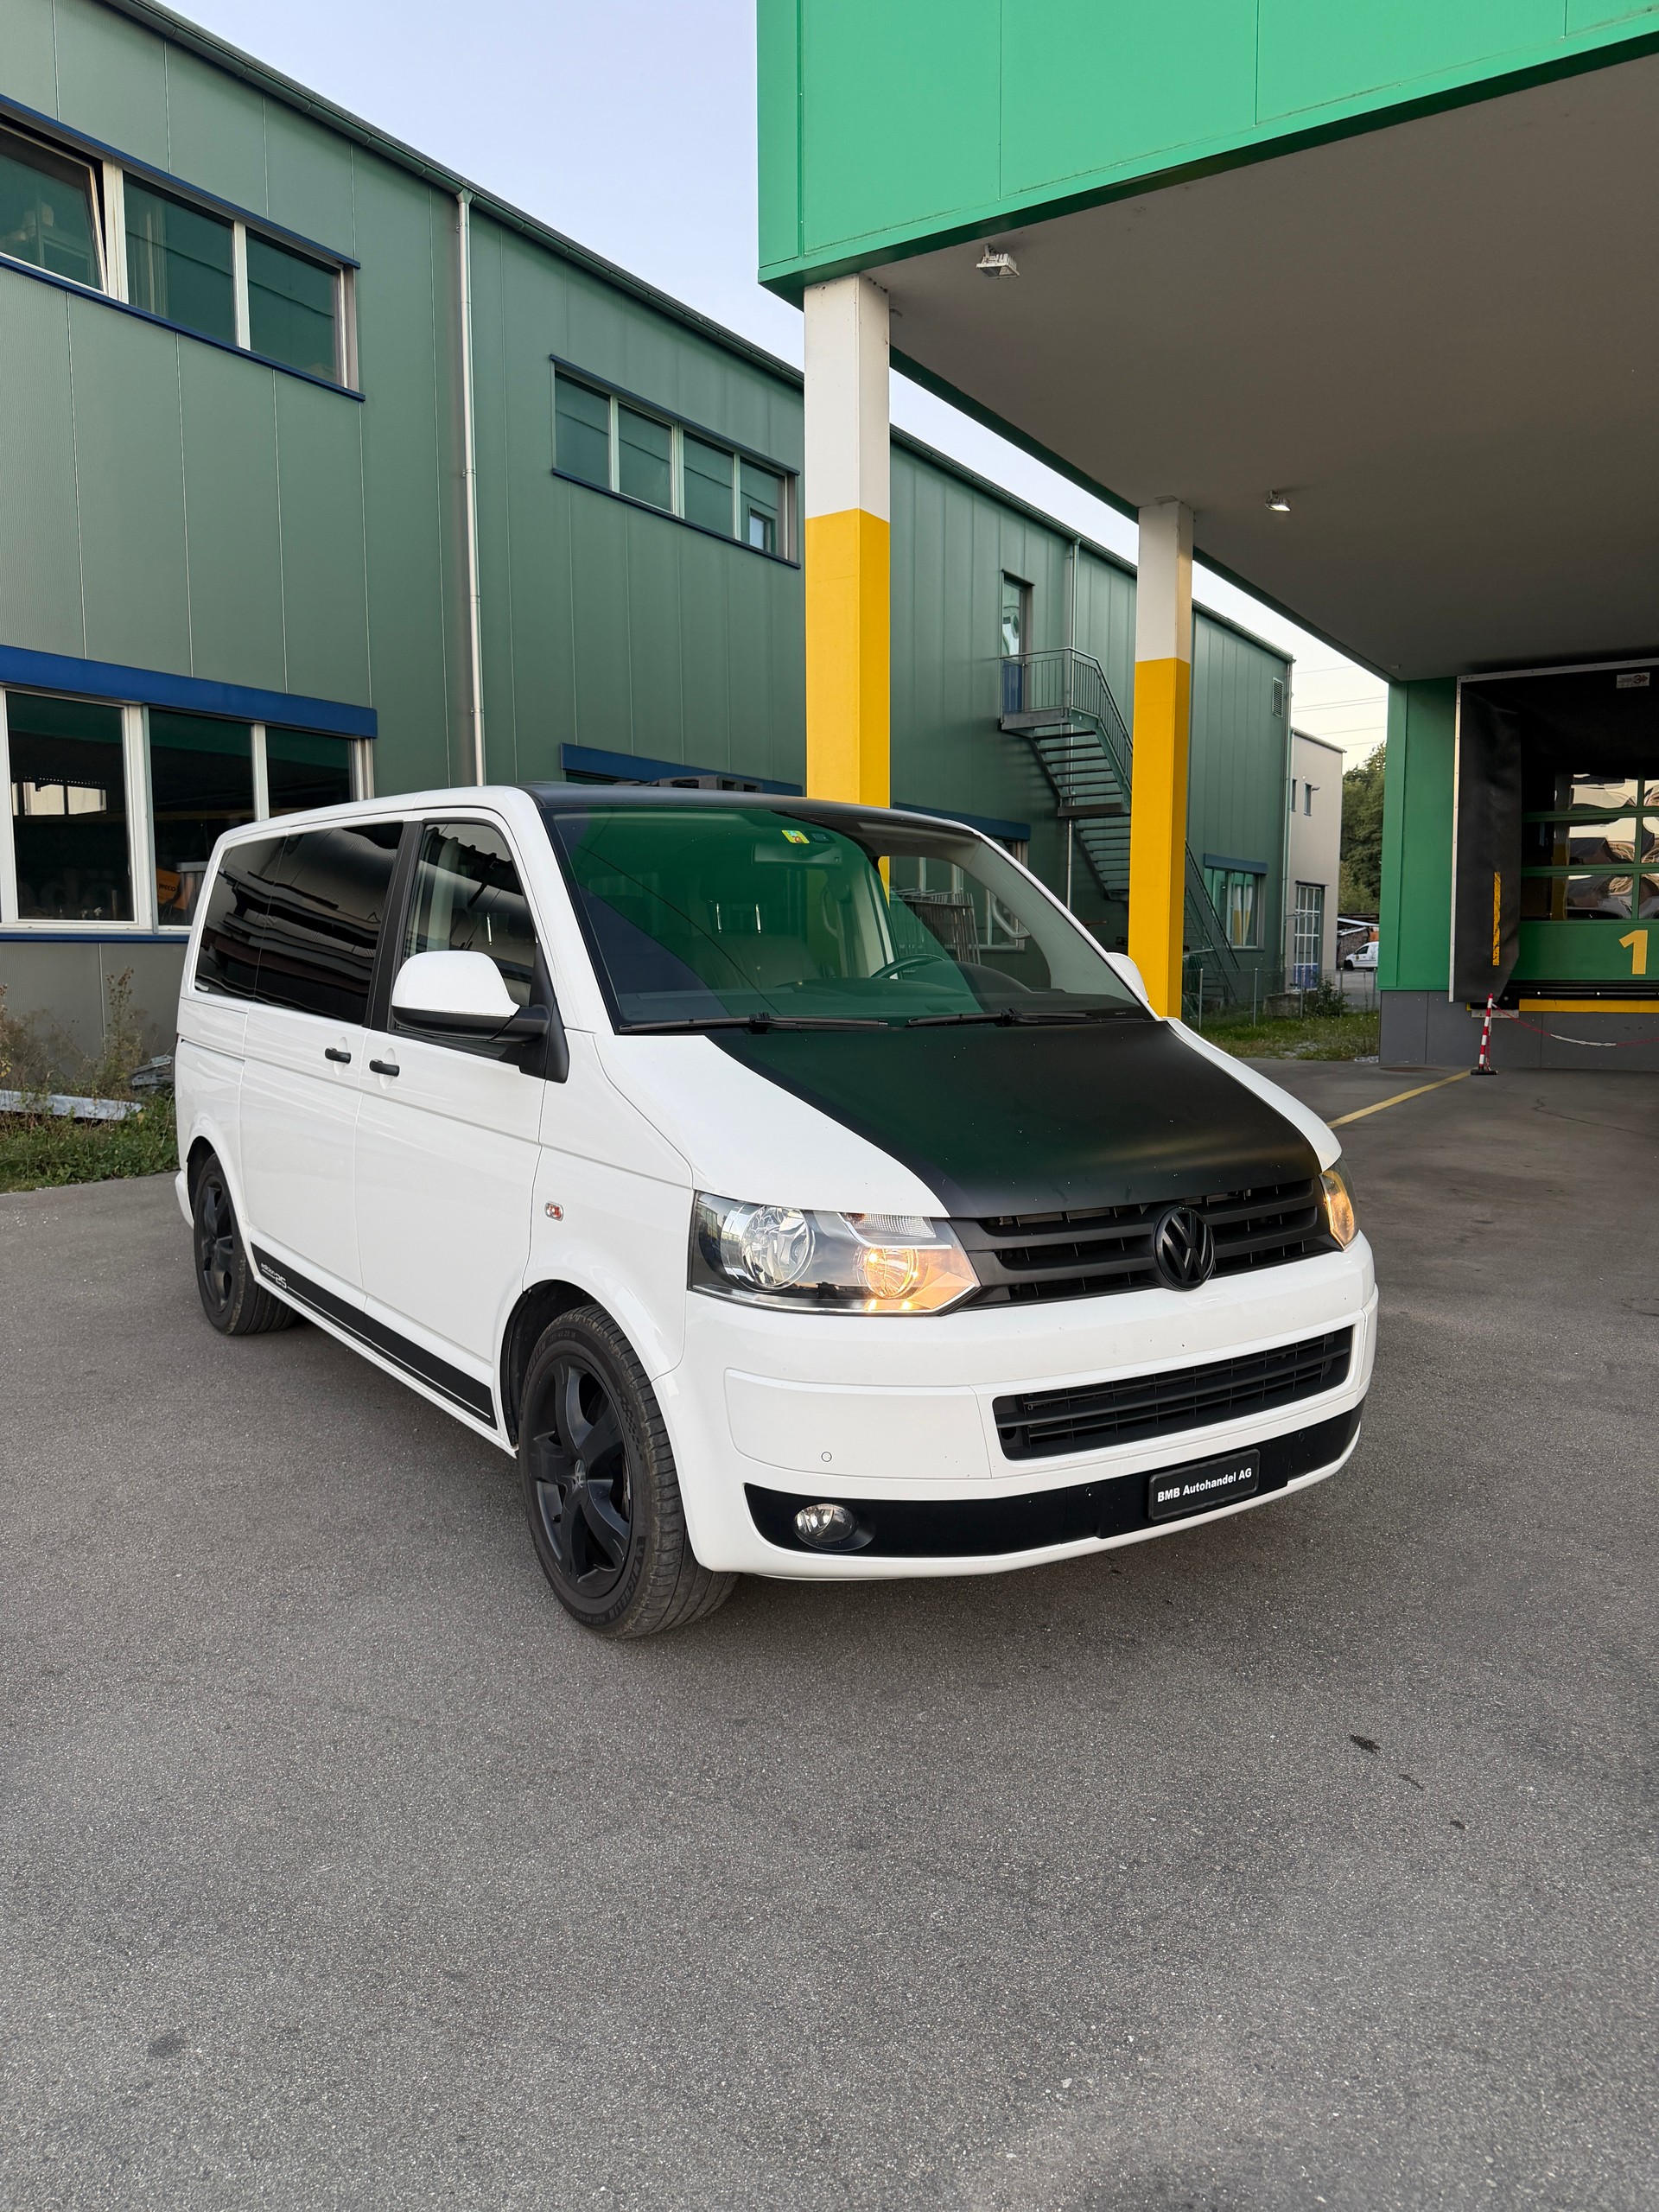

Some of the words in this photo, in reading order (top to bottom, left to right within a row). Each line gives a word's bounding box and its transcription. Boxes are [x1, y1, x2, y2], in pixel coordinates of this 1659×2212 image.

[1618, 930, 1648, 974] 1
[275, 1272, 287, 1289] 25
[1157, 1487, 1180, 1503] BMB
[1182, 1471, 1236, 1496] Autohandel
[1238, 1467, 1252, 1480] AG
